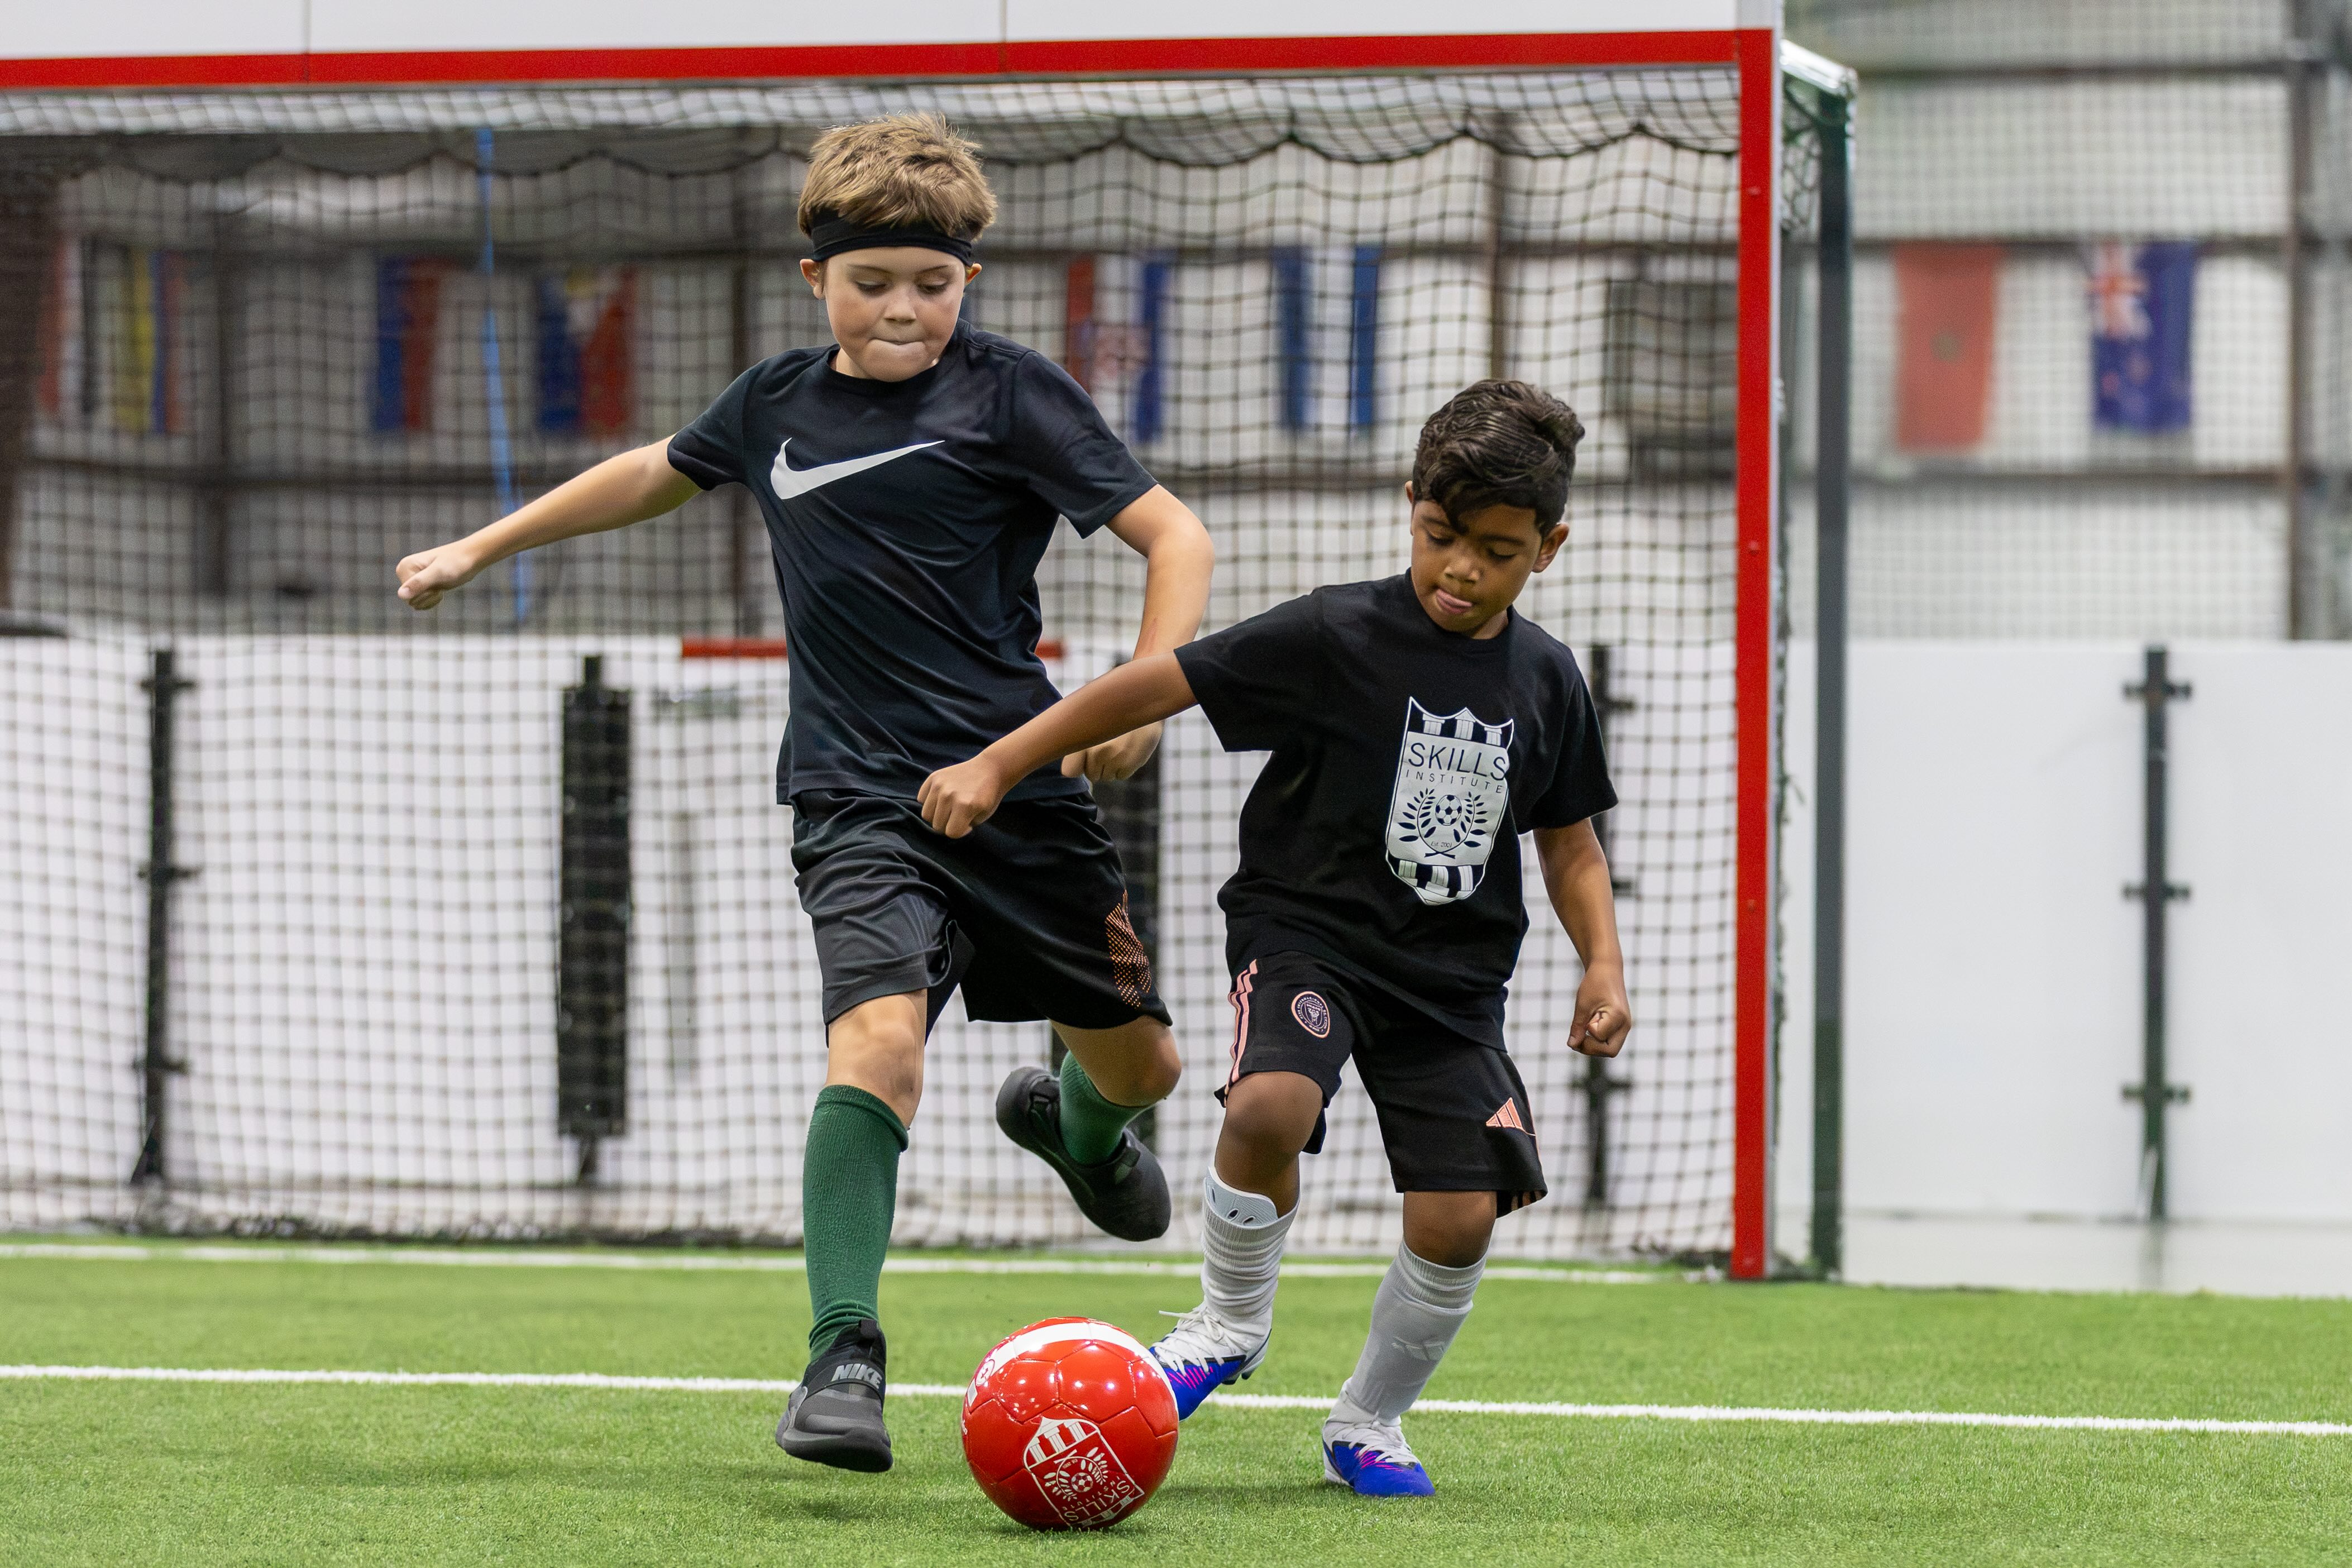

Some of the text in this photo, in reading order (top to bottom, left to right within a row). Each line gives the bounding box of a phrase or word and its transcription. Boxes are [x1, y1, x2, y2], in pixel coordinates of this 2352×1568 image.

[1408, 743, 1506, 780] SKILLS
[1406, 769, 1504, 793] INSTITUTE
[831, 1363, 882, 1389] NIKE
[1064, 1480, 1130, 1521] SKILLS
